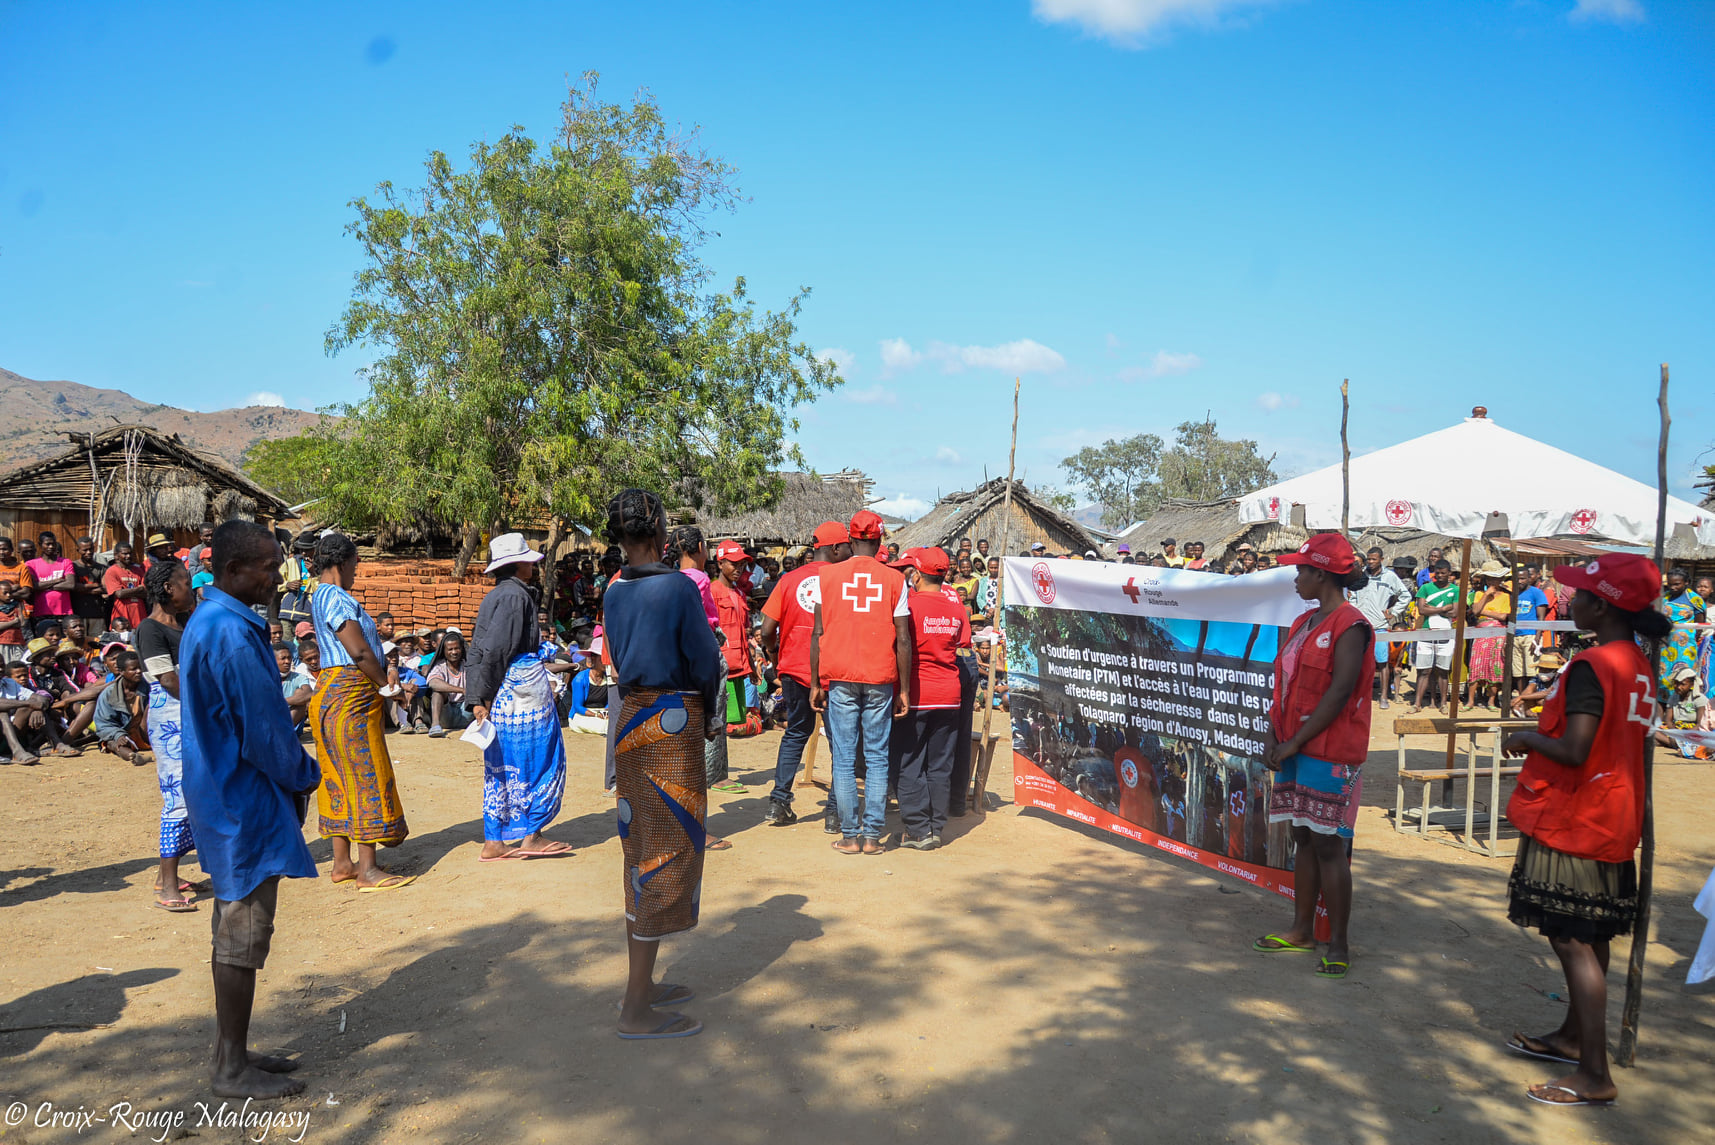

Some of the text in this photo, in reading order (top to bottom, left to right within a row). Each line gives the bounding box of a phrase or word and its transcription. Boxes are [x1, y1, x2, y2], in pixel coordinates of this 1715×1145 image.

[1046, 644, 1081, 660] Soutien
[1082, 648, 1129, 667] d'urgence
[1131, 653, 1137, 669] à
[1139, 655, 1178, 674] travers
[1180, 662, 1194, 677] un
[1196, 662, 1265, 685] Programme
[1268, 672, 1275, 689] d
[1047, 661, 1092, 681] Monetaire
[1093, 667, 1120, 687] (PTM)
[1122, 674, 1133, 687] et
[1133, 674, 1171, 694] l'accès
[1173, 680, 1180, 695] à
[1181, 681, 1210, 701] l'eau
[1212, 688, 1239, 706] pour
[1241, 691, 1260, 709] les
[1064, 683, 1270, 733] affectées par la sécheresse dans le dis
[1078, 703, 1265, 755] Tolagnaro, région d'Anosy, Madagas
[1066, 809, 1096, 824] IMPARTIALITE
[1112, 824, 1142, 840] NEUTRALITE
[1157, 839, 1199, 860] INDEPENDANCE
[1217, 860, 1258, 882] VOLONTARIAT
